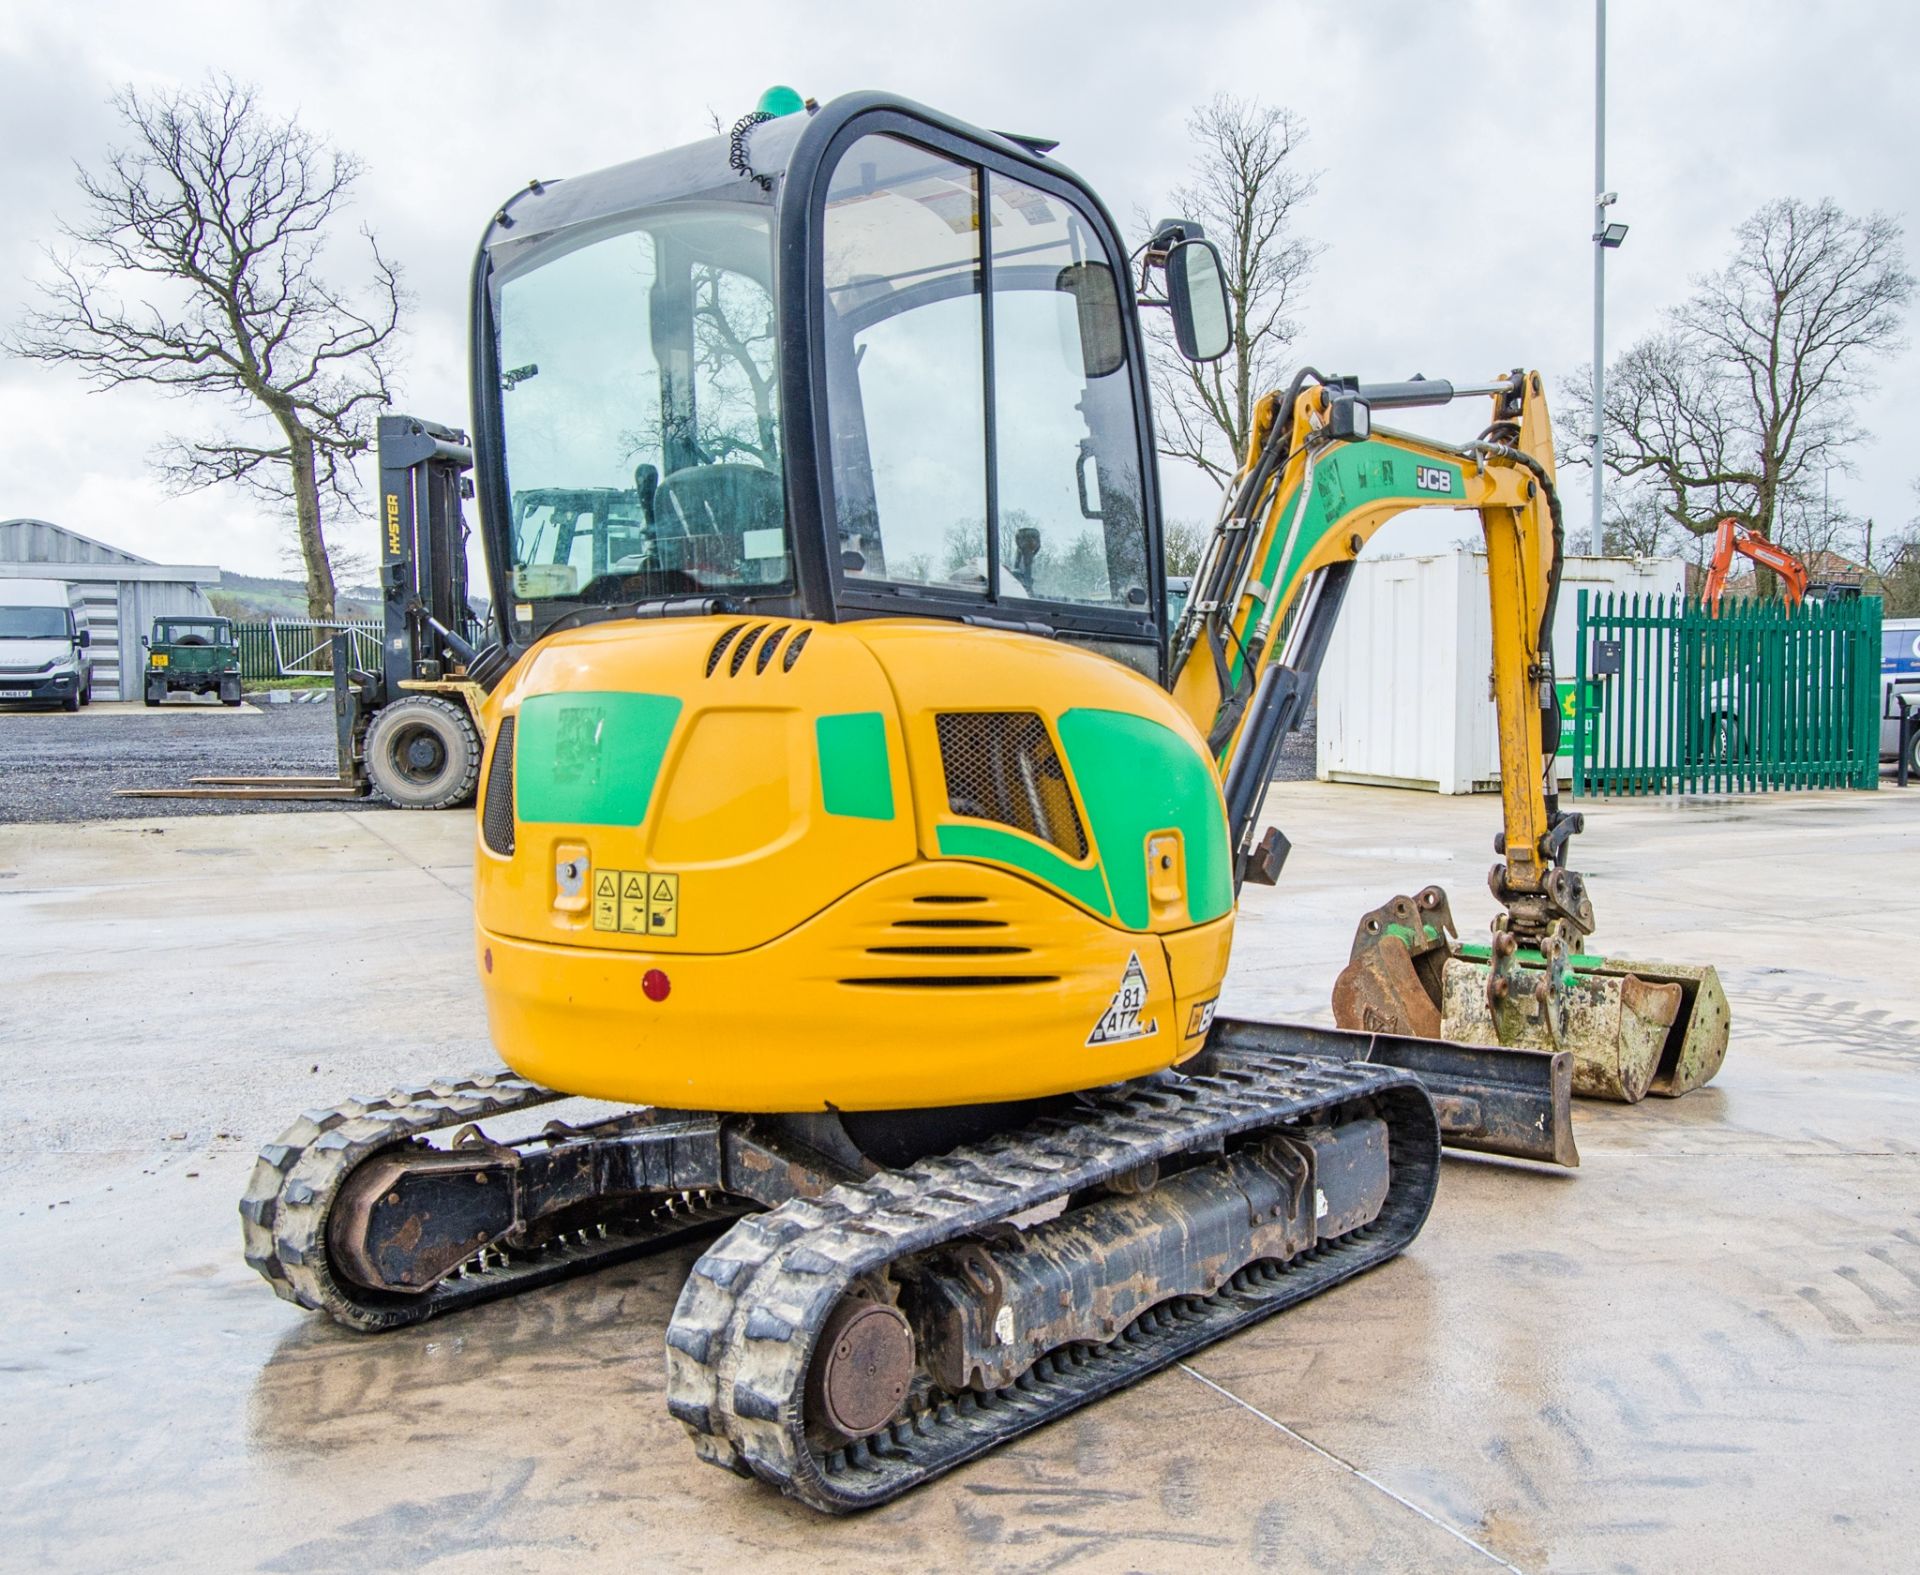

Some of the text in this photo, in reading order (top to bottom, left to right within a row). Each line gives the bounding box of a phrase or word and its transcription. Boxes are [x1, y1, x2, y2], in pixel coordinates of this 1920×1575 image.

[1417, 467, 1451, 492] JCB
[387, 494, 401, 555] HYSTER
[1122, 987, 1140, 1009] 81
[1107, 1010, 1141, 1032] AT7
